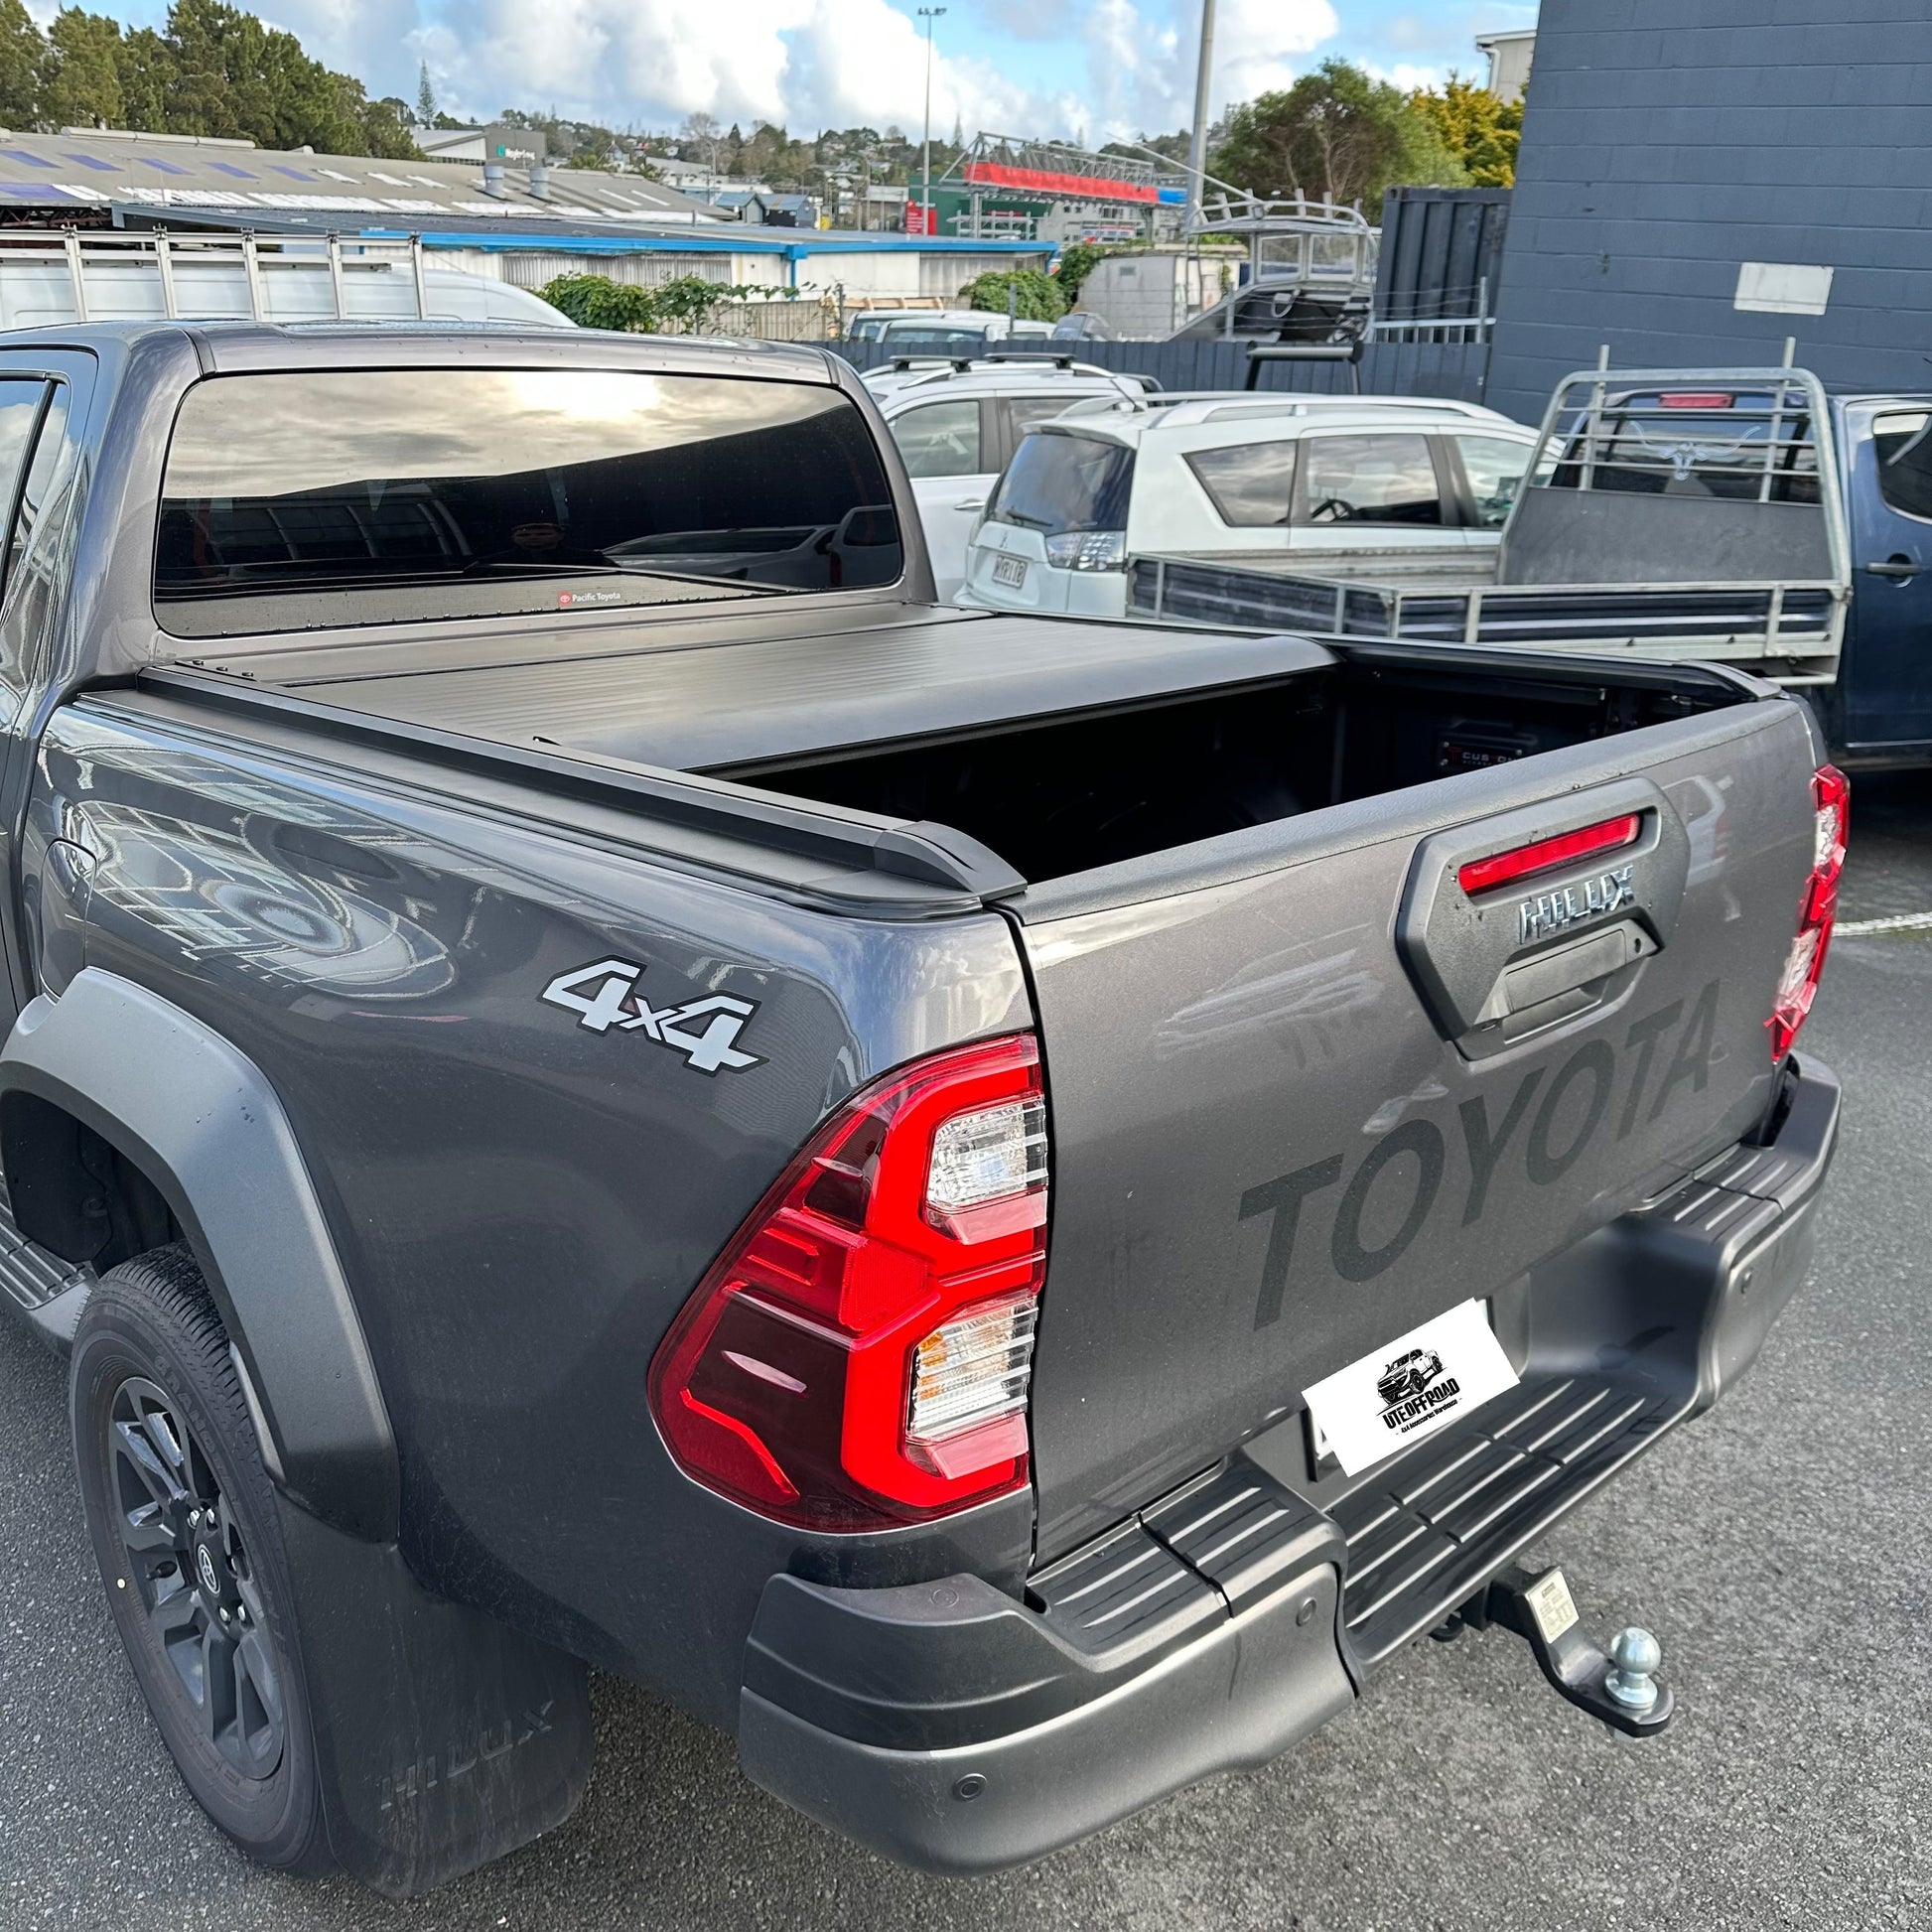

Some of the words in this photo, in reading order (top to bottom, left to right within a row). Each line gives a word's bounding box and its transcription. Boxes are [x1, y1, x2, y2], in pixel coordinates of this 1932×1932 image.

[572, 593, 596, 602] Pacific
[596, 592, 621, 602] Toyota
[1519, 865, 1634, 944] HILUX
[539, 956, 764, 1075] 4x4
[1237, 978, 1721, 1331] TOYOTA
[380, 1699, 555, 1810] HILUX
